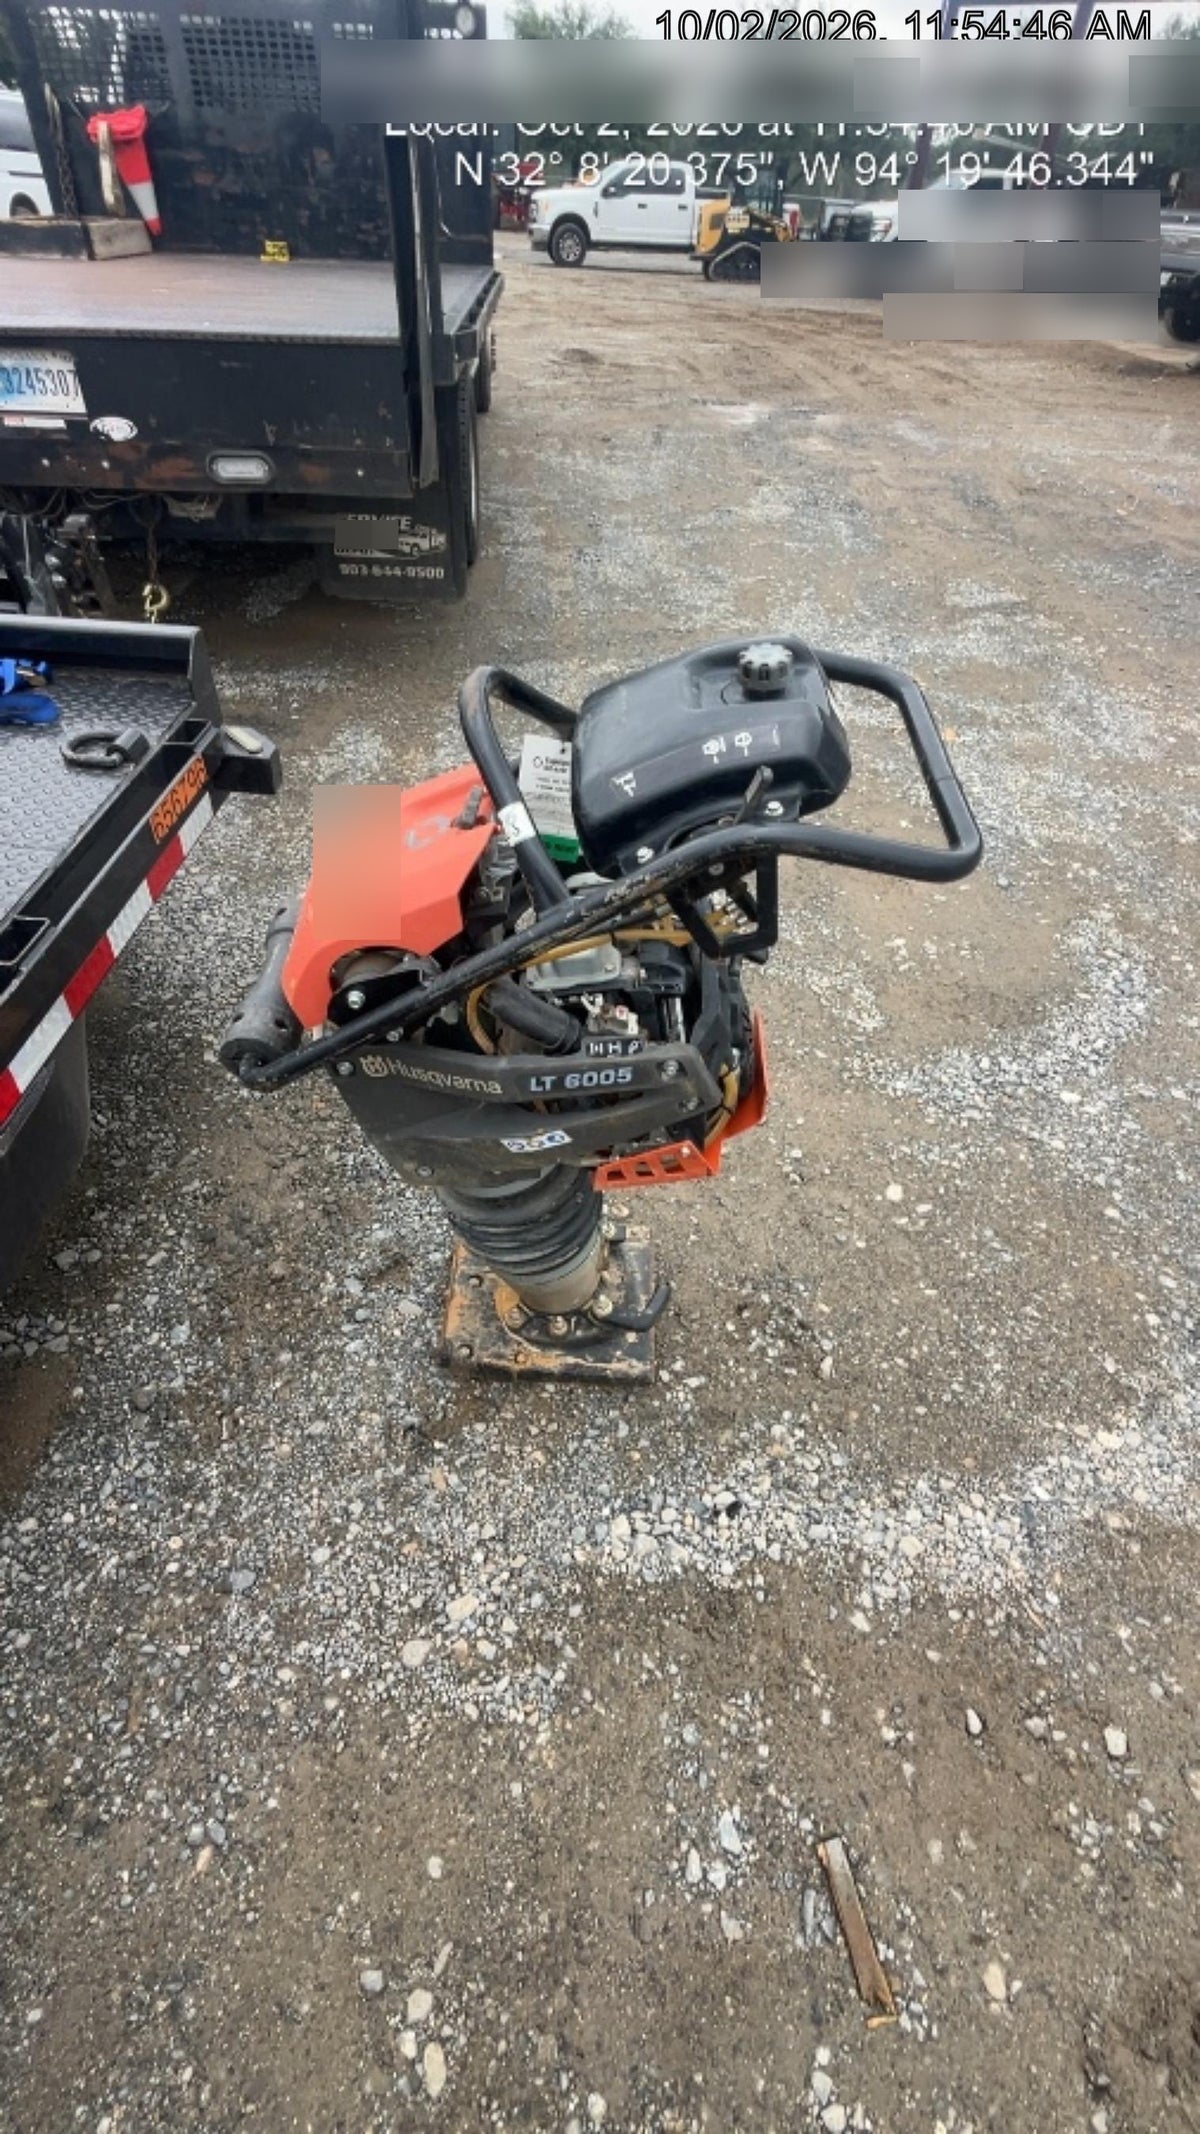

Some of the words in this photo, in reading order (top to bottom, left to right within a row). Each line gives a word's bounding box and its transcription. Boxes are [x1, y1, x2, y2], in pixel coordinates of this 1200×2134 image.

[386, 1057, 503, 1094] Husqvarna
[530, 1076, 557, 1092] LT
[564, 1066, 632, 1089] 6005
